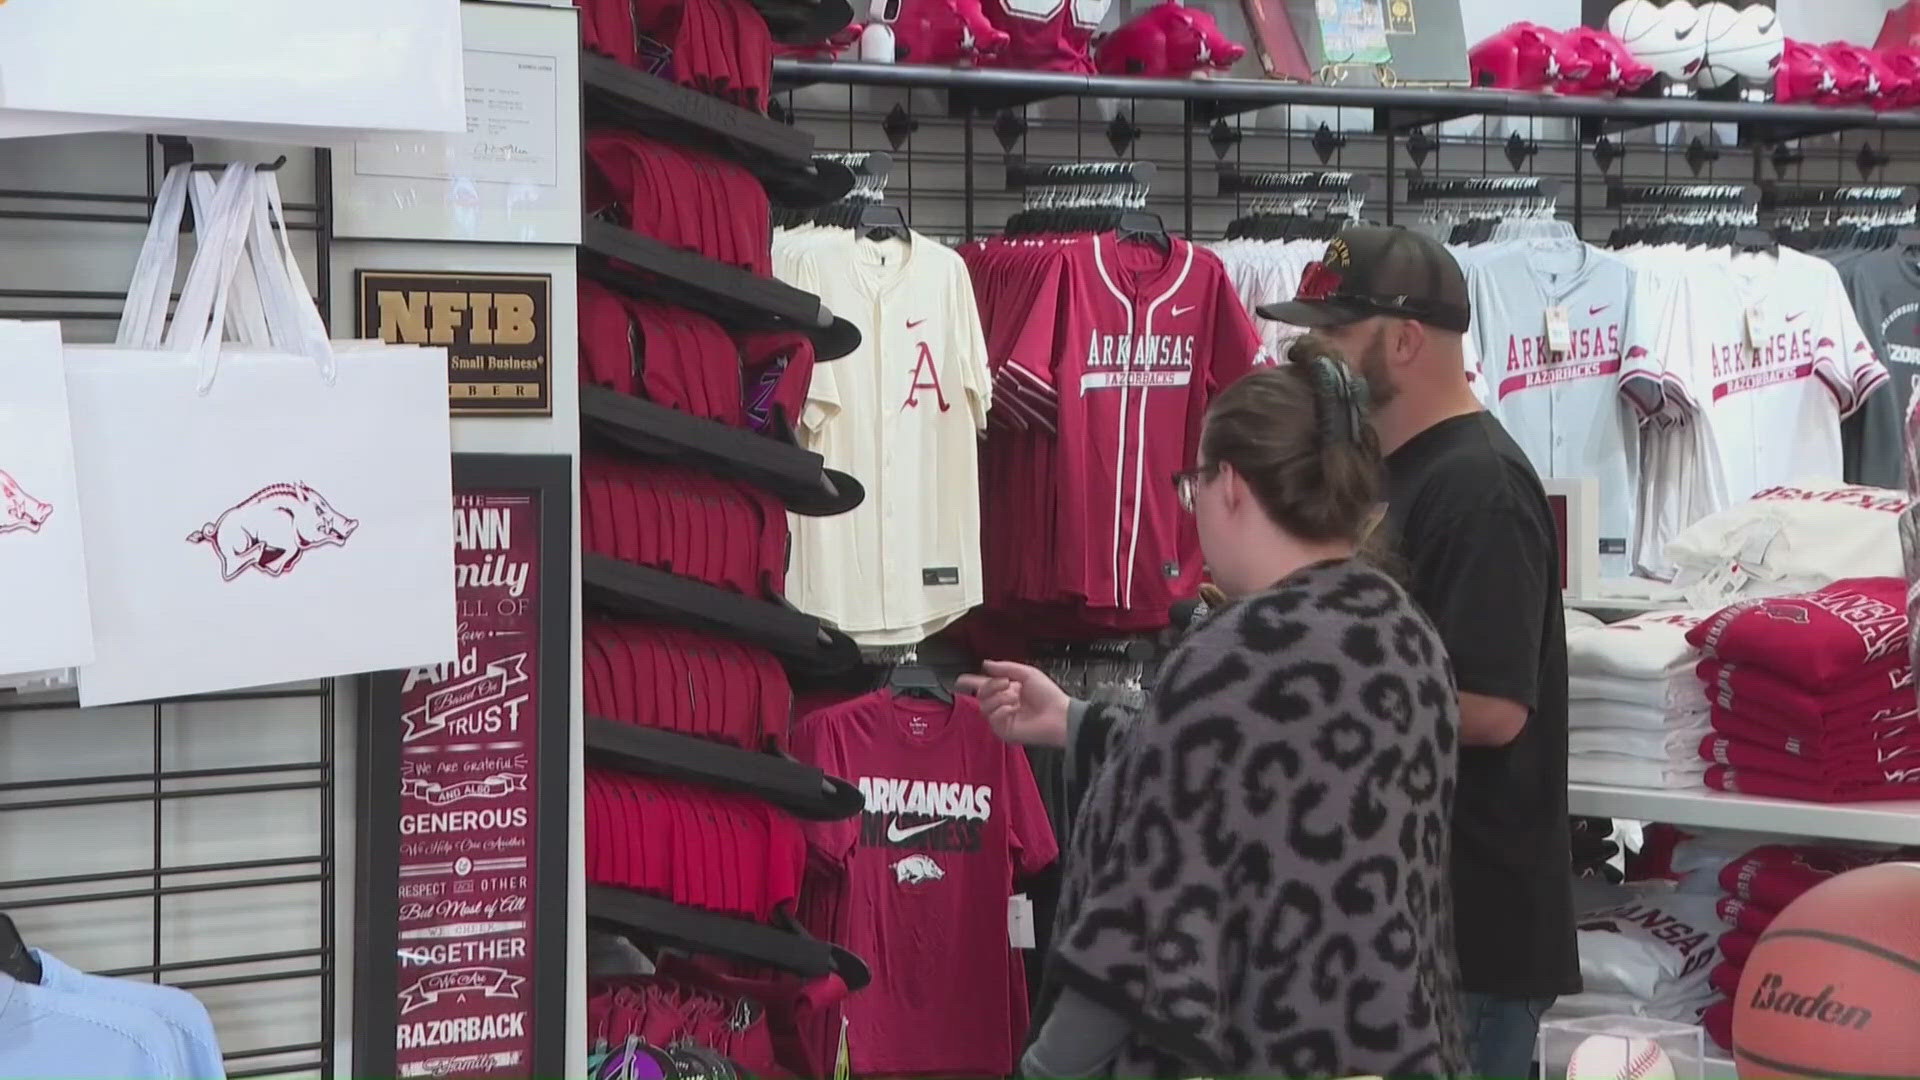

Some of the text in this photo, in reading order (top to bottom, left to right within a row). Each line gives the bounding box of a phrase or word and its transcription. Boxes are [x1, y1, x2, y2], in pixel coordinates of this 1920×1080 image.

[377, 290, 536, 344] NFIB
[1087, 328, 1194, 366] ARKANSAS
[451, 355, 484, 369] Small
[1525, 363, 1600, 388] RAZORBACKS
[449, 385, 524, 396] BER
[901, 341, 951, 413] A
[1105, 373, 1175, 385] RAZORBACKS
[454, 508, 510, 550] ANN
[455, 554, 529, 597] mily
[498, 599, 530, 616] OF
[434, 686, 476, 711] Based
[448, 694, 529, 736] TRUST
[416, 761, 431, 776] We
[439, 784, 490, 801] AND ALSO
[858, 776, 992, 822] ARKANSAS
[399, 807, 528, 835] GENEROUS
[398, 882, 446, 899] RESPECT
[481, 876, 527, 892] OTHER
[399, 894, 527, 921] But Most of All
[400, 937, 526, 968] TOGETHER
[429, 971, 487, 988] We Are
[457, 993, 466, 1003] A
[1750, 972, 1873, 1030] Baden
[396, 1012, 524, 1050] RAZORBACK
